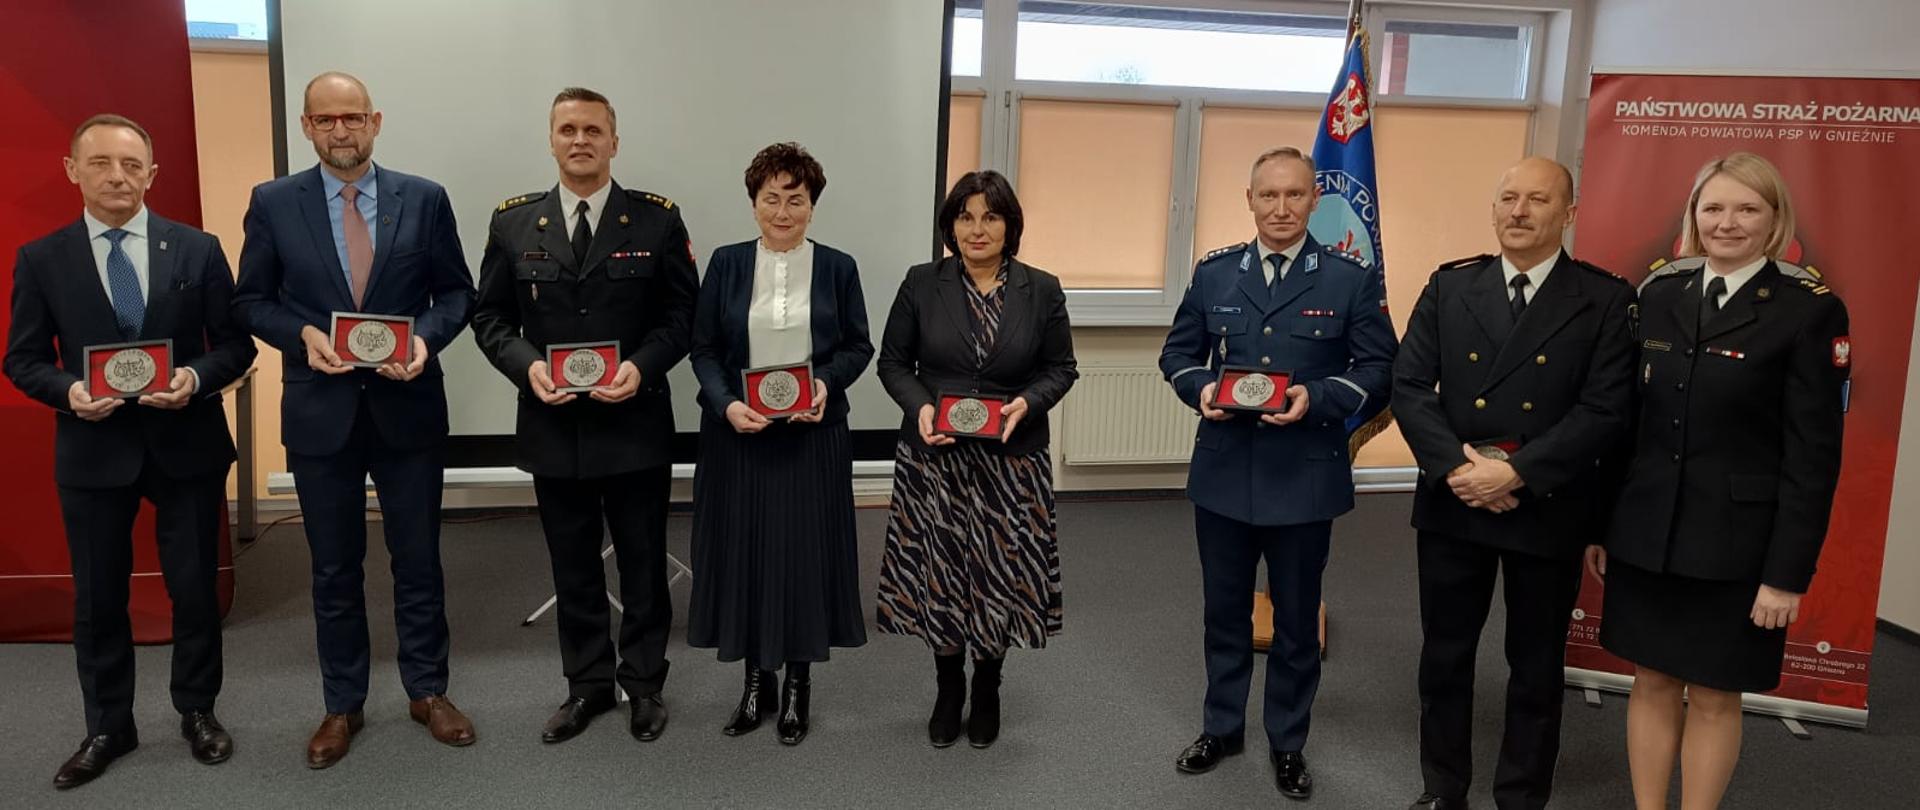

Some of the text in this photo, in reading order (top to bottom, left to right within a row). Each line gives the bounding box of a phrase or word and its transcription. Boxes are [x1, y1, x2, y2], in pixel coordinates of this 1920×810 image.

[1615, 96, 1920, 123] PAŃSTWOWA STRAŻ POŻARNA
[1622, 124, 1896, 143] KOMENDA POWIATOWA PSP W GNIEŹNIE
